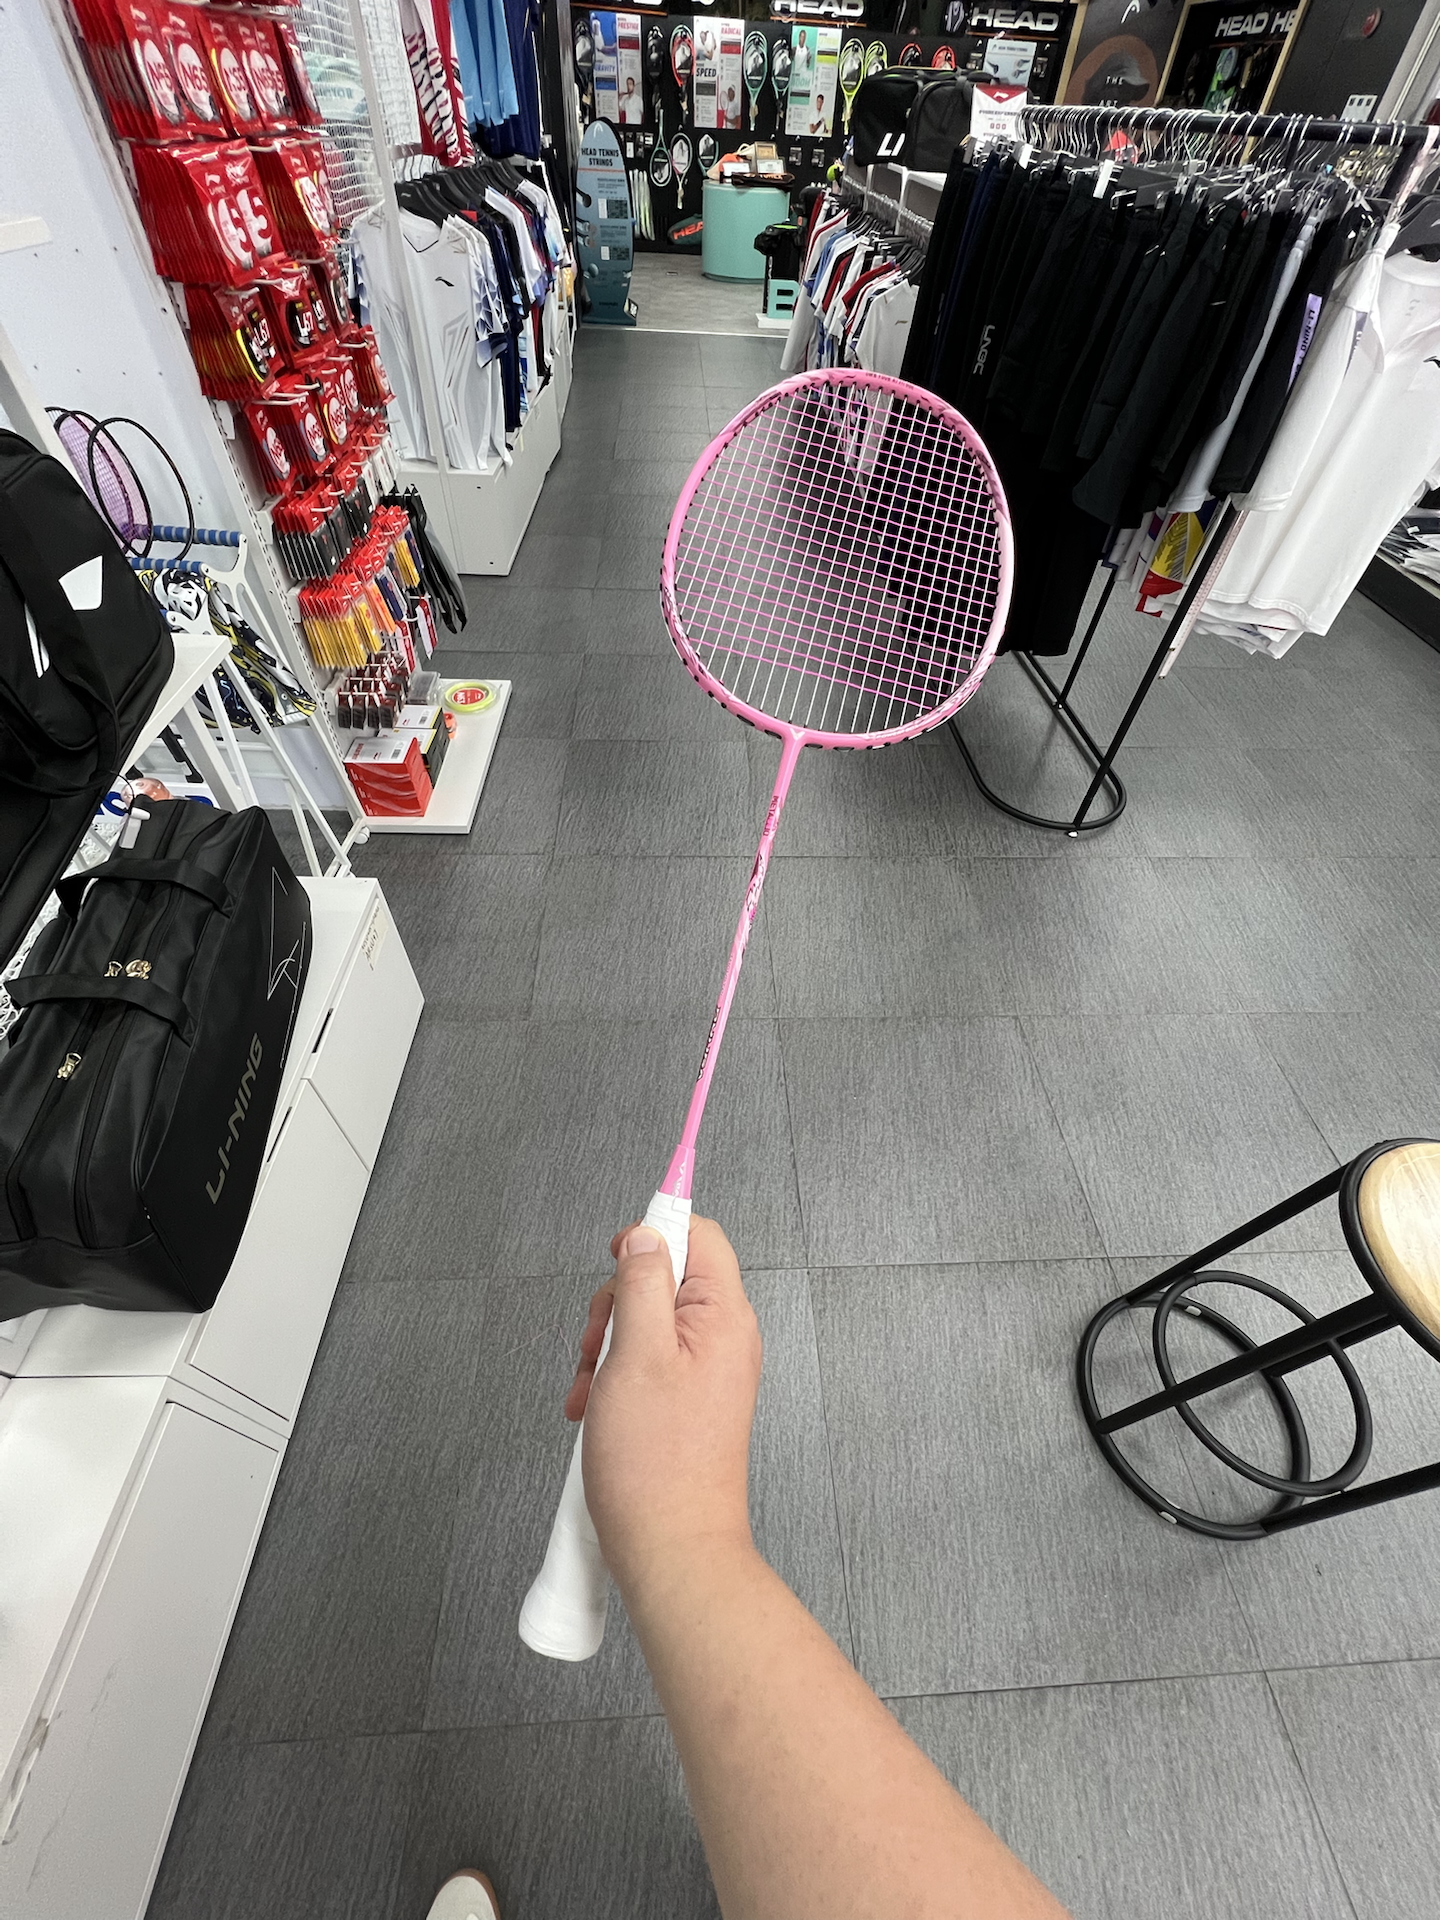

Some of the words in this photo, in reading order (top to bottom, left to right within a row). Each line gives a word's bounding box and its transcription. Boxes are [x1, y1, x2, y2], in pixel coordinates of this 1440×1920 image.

[774, 0, 864, 17] HEAD
[971, 7, 1059, 33] HEAD
[1215, 12, 1269, 37] HEAD
[695, 67, 717, 78] SPEED
[1105, 75, 1124, 86] THE
[581, 147, 597, 157] HEAD
[599, 148, 620, 158] TENNIS
[588, 157, 613, 167] STRINGS
[295, 311, 315, 333] L67
[1298, 307, 1315, 353] LI-NING
[205, 1032, 264, 1205] LI-NING
